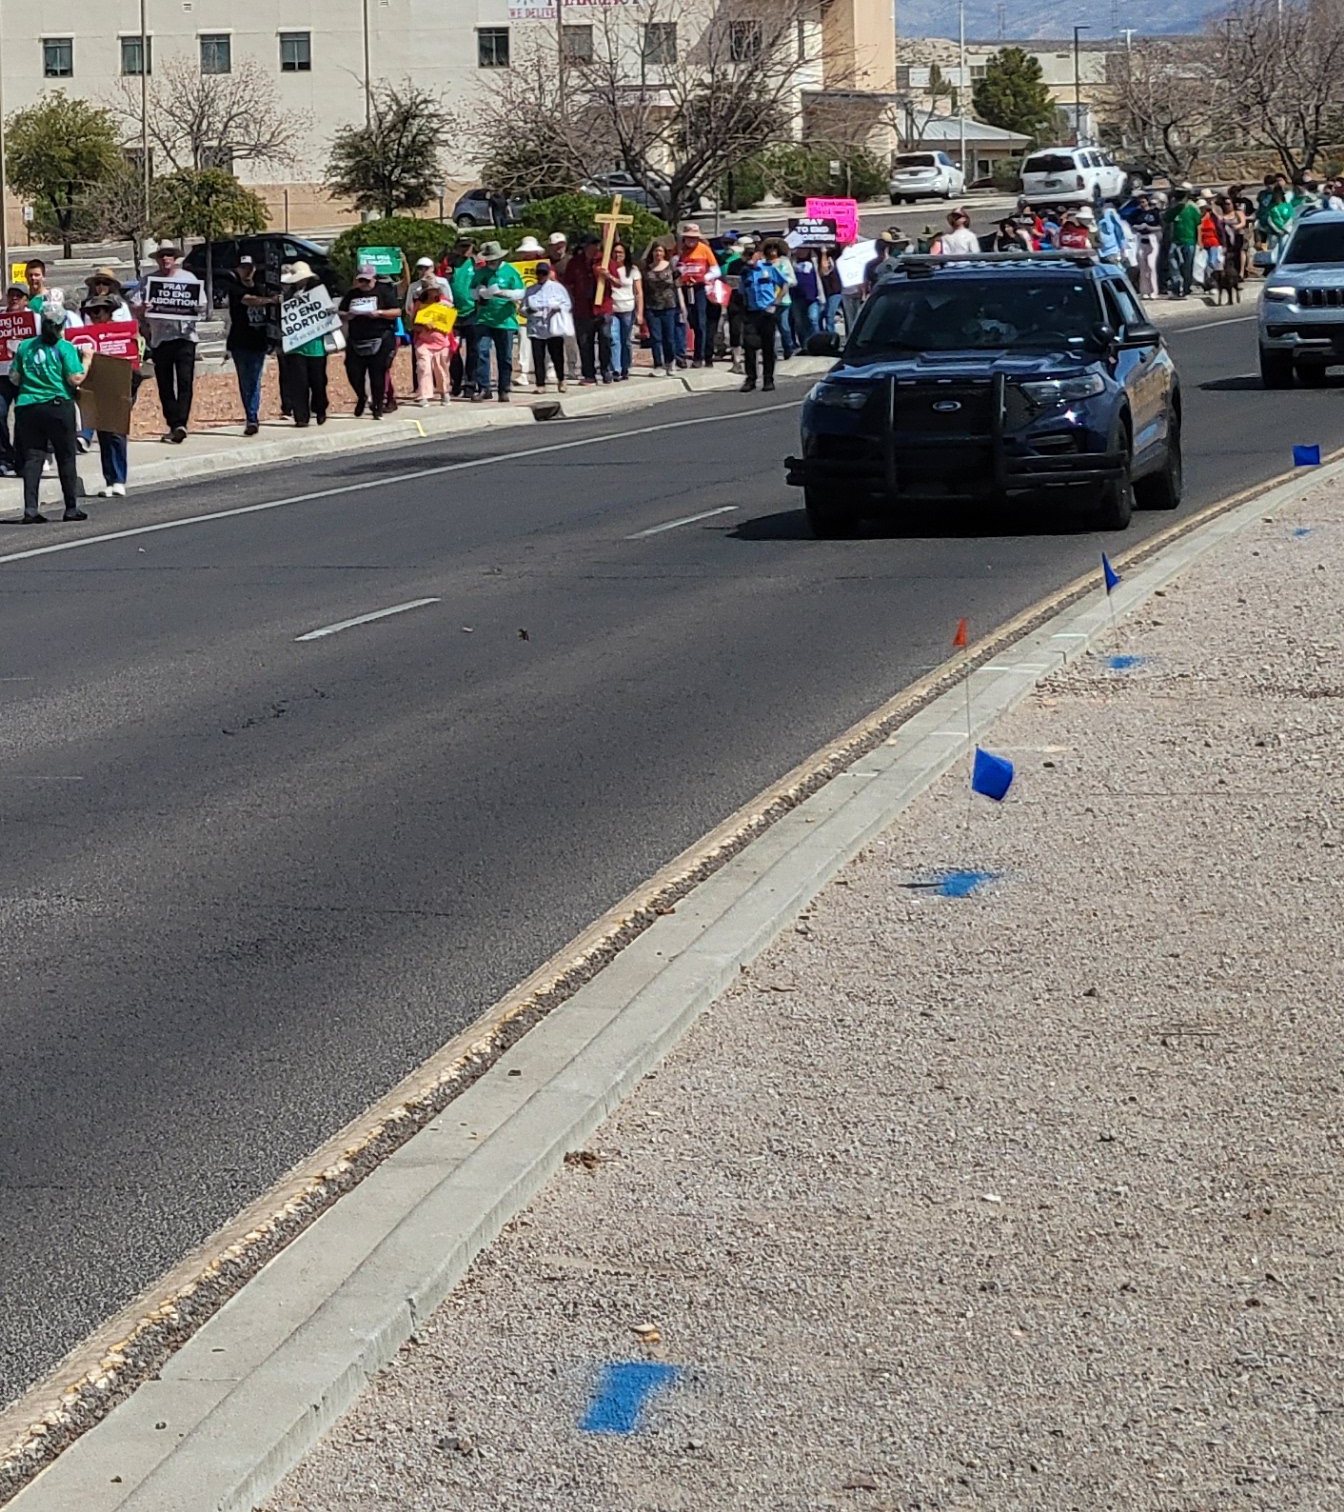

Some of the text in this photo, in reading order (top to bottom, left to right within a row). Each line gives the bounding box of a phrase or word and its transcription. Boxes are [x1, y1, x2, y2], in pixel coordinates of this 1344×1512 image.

[157, 289, 170, 297] TO
[150, 297, 198, 306] ABORTION
[283, 293, 310, 313] PRAY
[282, 312, 297, 325] TO
[298, 301, 322, 317] END
